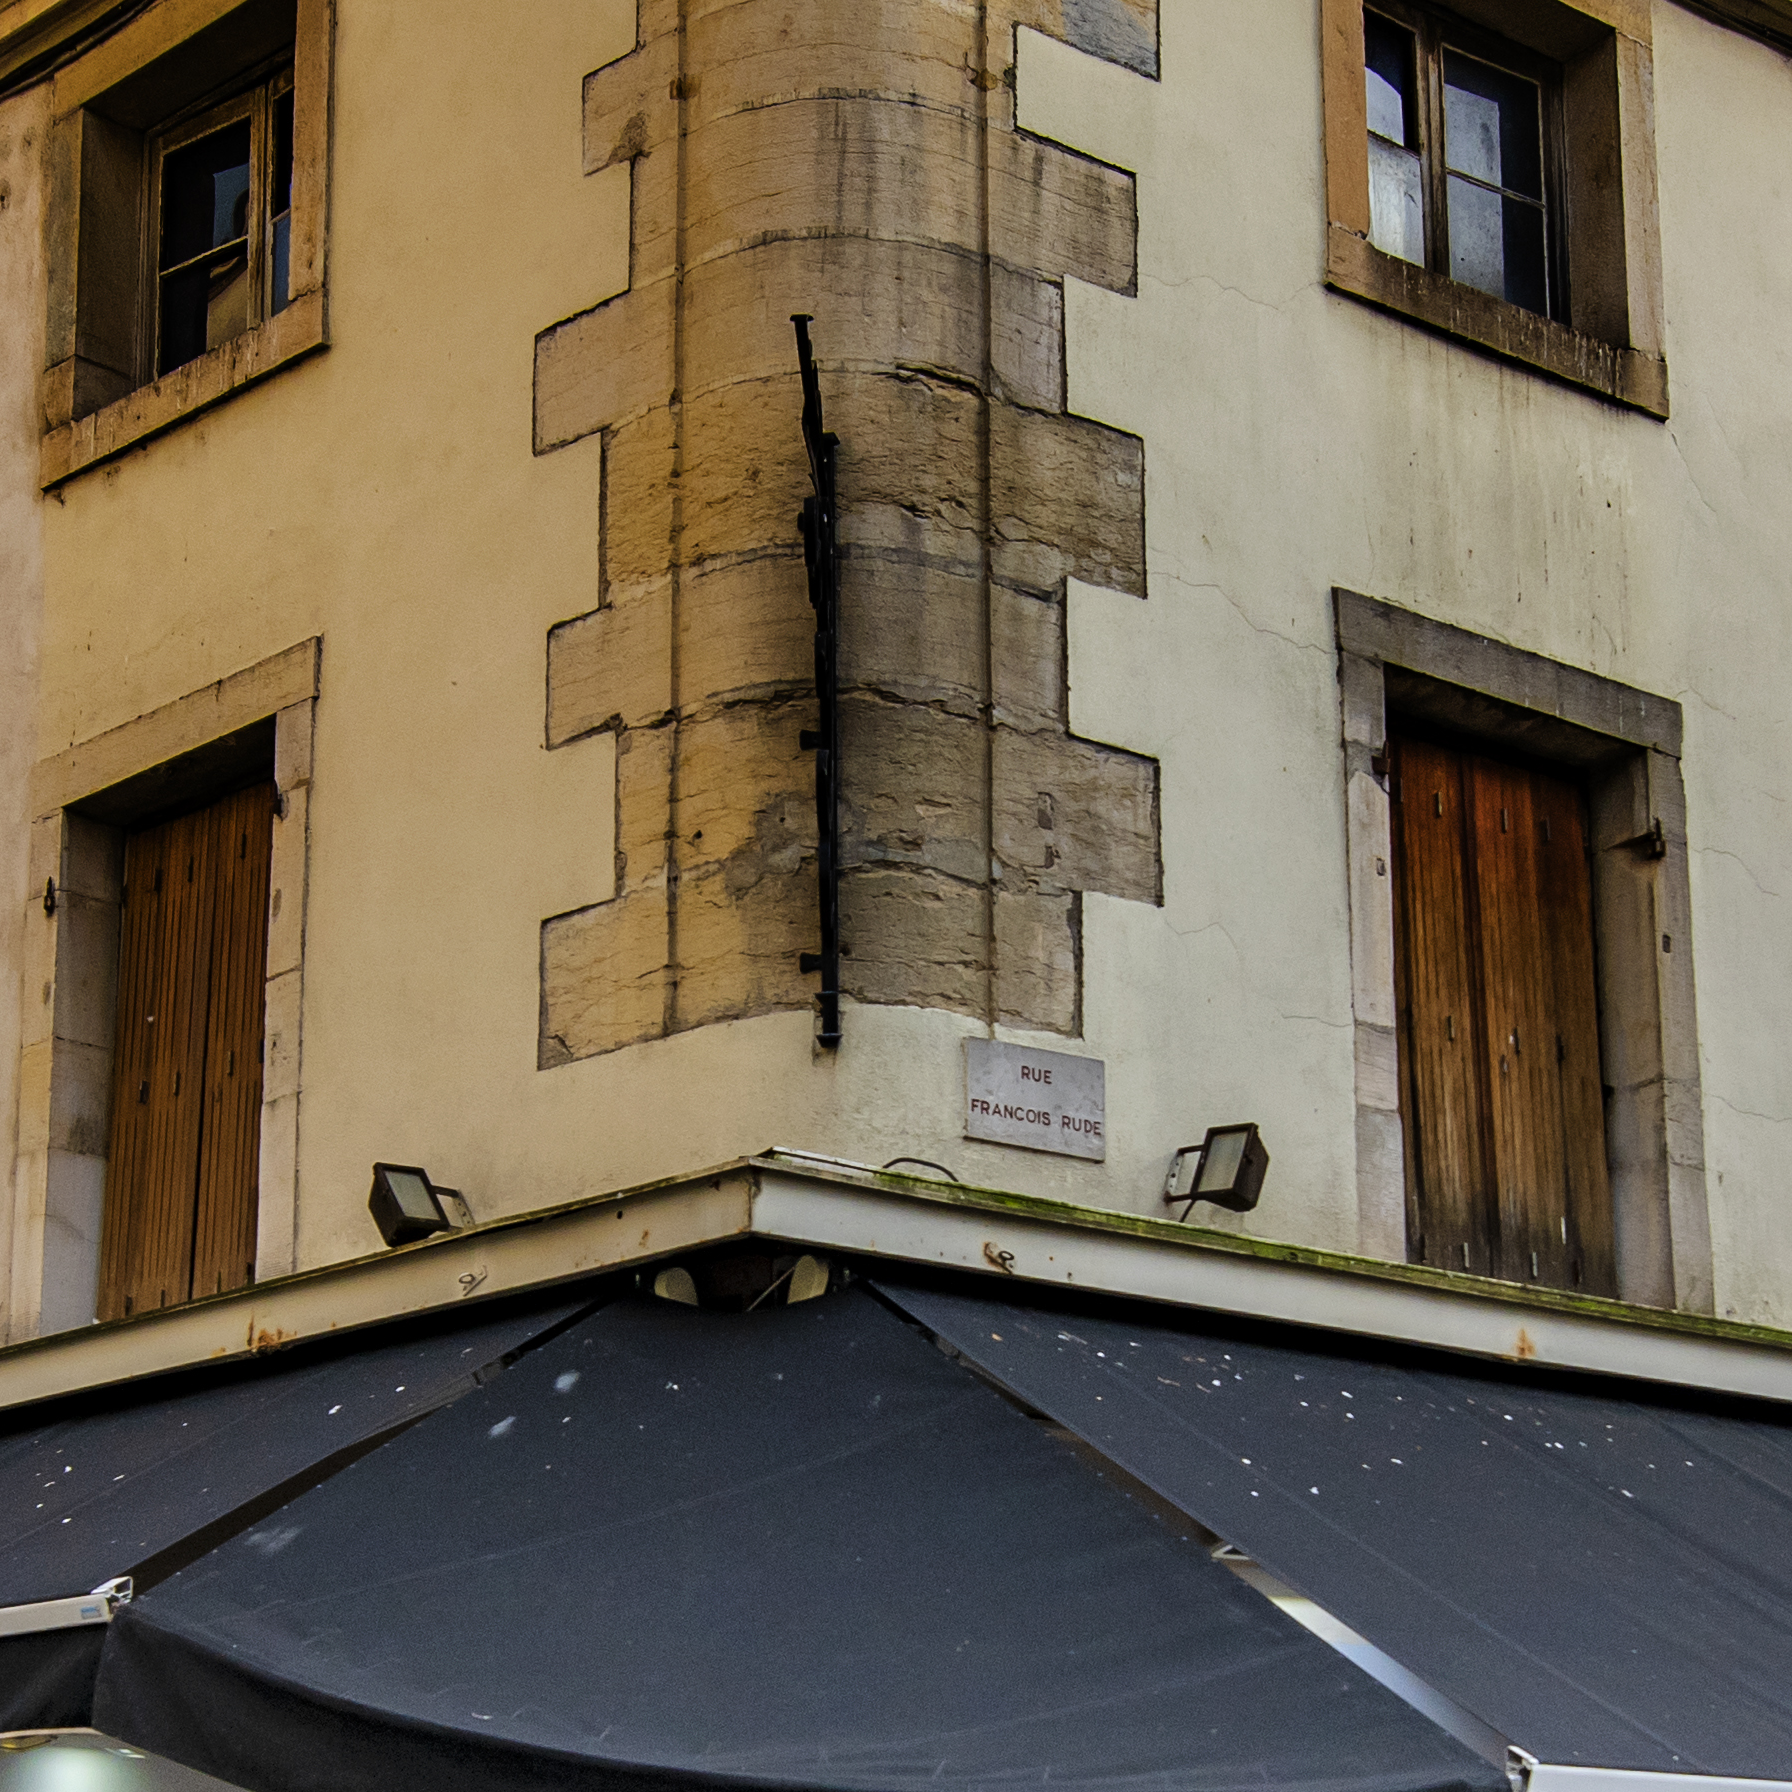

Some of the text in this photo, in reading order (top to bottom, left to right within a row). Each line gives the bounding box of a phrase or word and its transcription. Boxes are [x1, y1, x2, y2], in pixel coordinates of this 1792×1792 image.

[1021, 1065, 1053, 1085] RUE
[970, 1098, 1102, 1136] FRANCOIS RUDE
